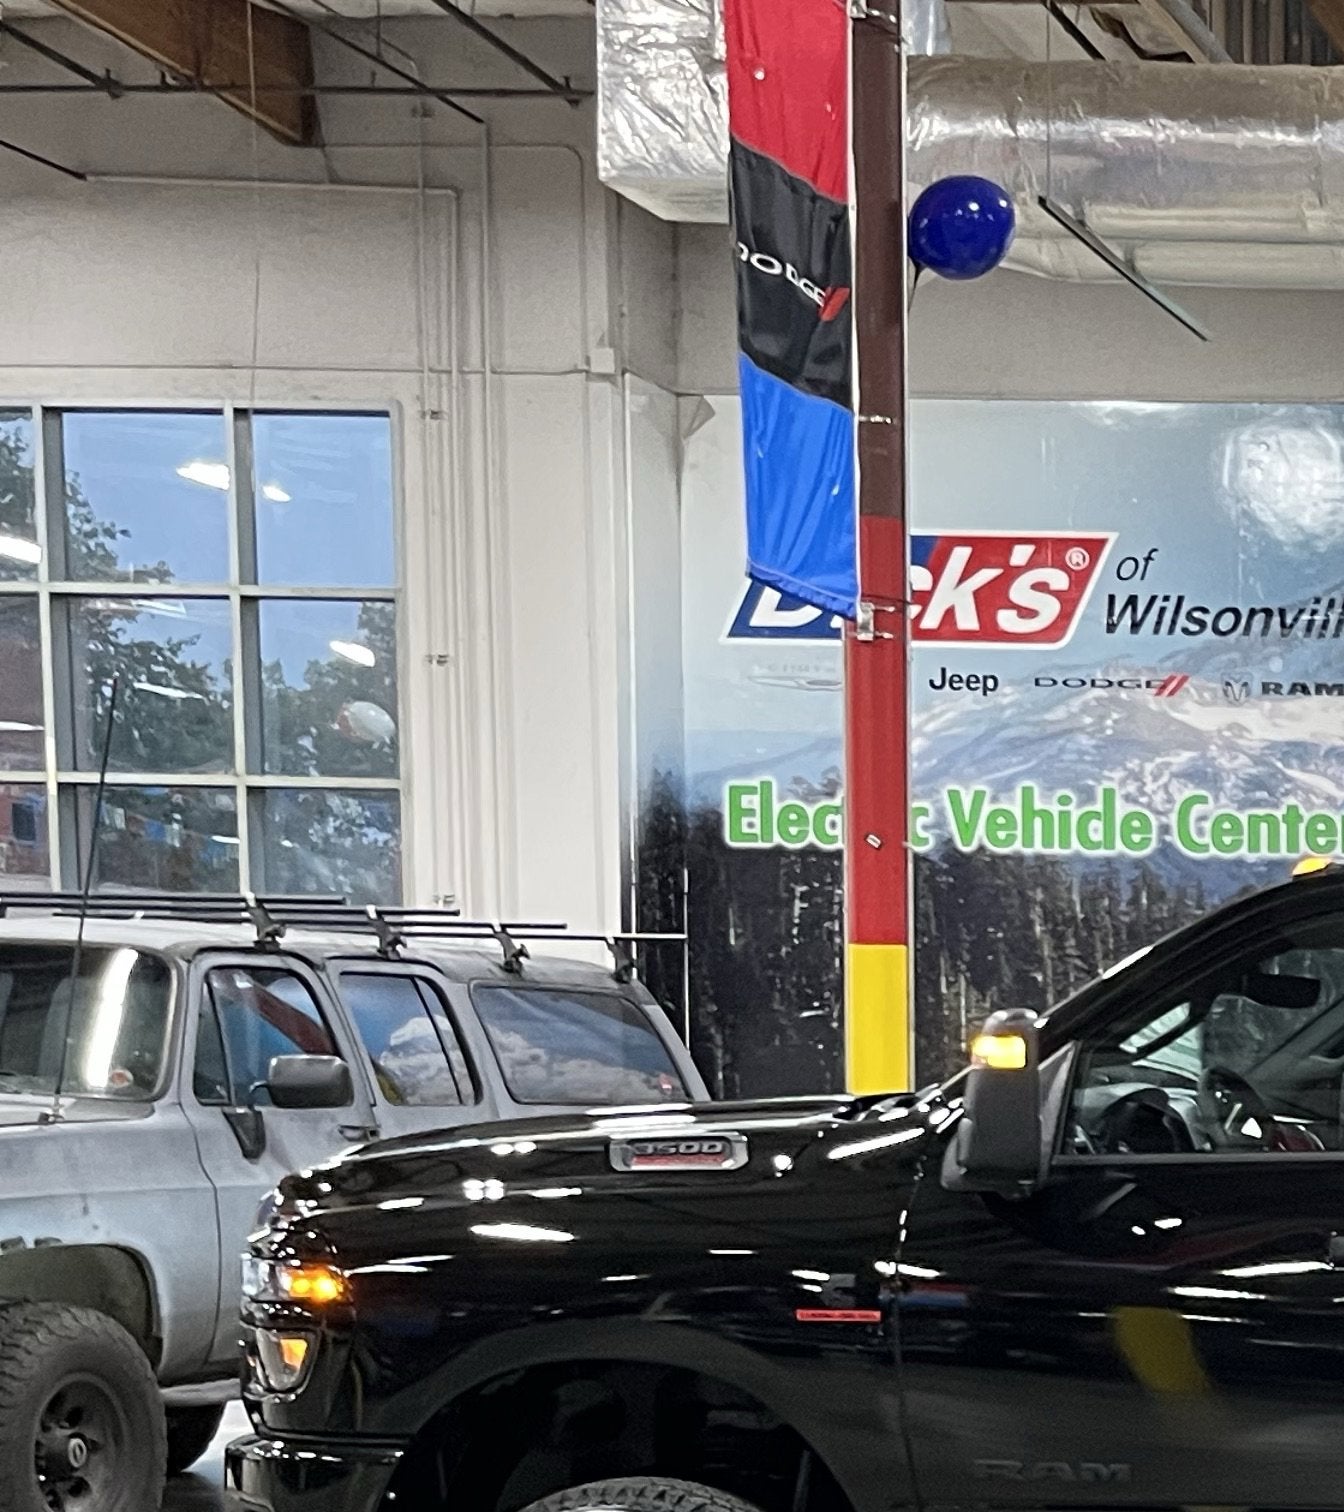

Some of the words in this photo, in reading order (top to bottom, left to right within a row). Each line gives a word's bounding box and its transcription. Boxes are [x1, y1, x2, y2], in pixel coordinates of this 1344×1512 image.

[1116, 547, 1160, 582] of
[748, 543, 1071, 635] k's
[929, 667, 999, 696] Jeep
[1034, 676, 1168, 690] DODGE
[727, 780, 930, 848] Elecc
[948, 786, 1153, 852] Vehicle
[633, 1140, 723, 1155] 3500
[973, 1458, 1132, 1482] RAM
